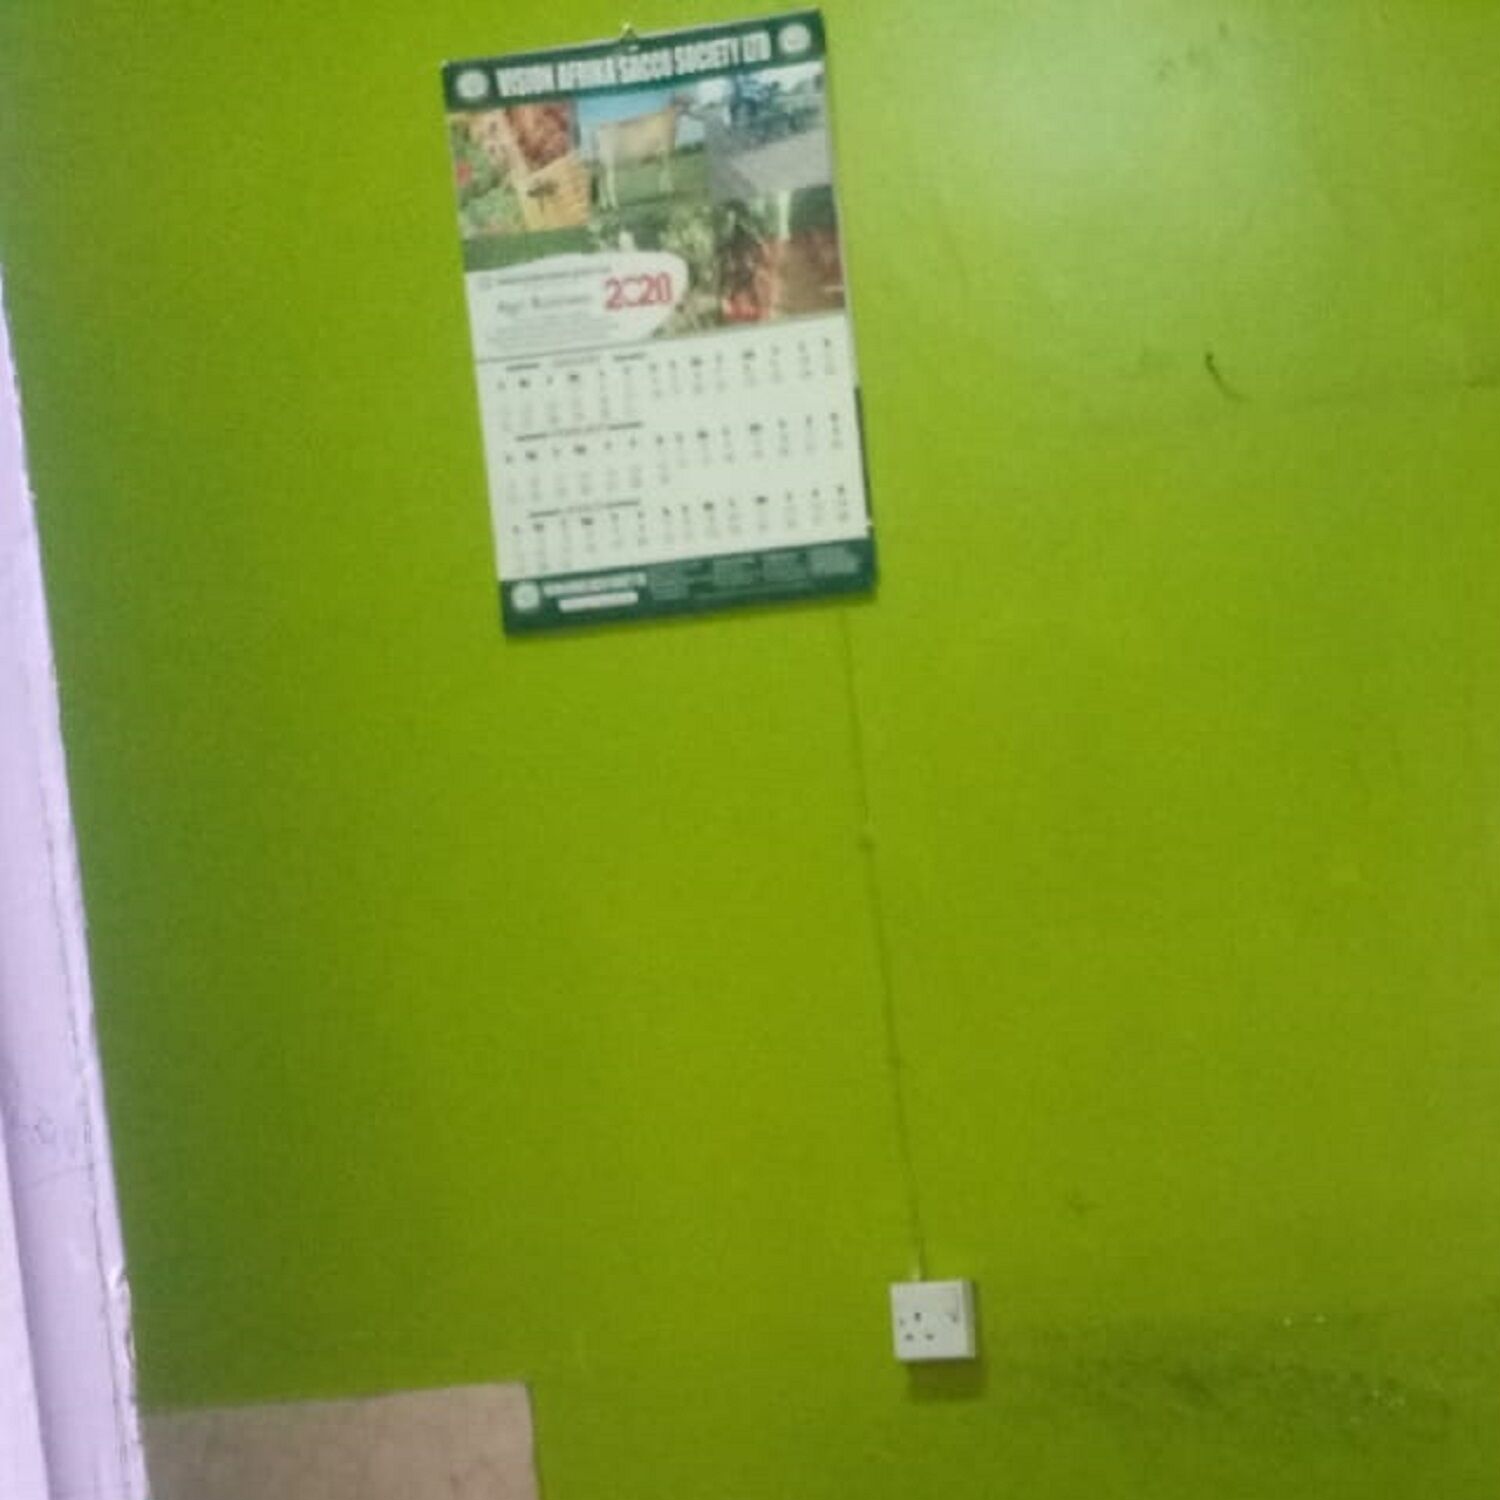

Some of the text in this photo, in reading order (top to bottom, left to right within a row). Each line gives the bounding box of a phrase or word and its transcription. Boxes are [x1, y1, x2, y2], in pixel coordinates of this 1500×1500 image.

[617, 48, 674, 84] SACCO
[674, 38, 740, 75] SOCIETY
[605, 272, 673, 311] 2020
